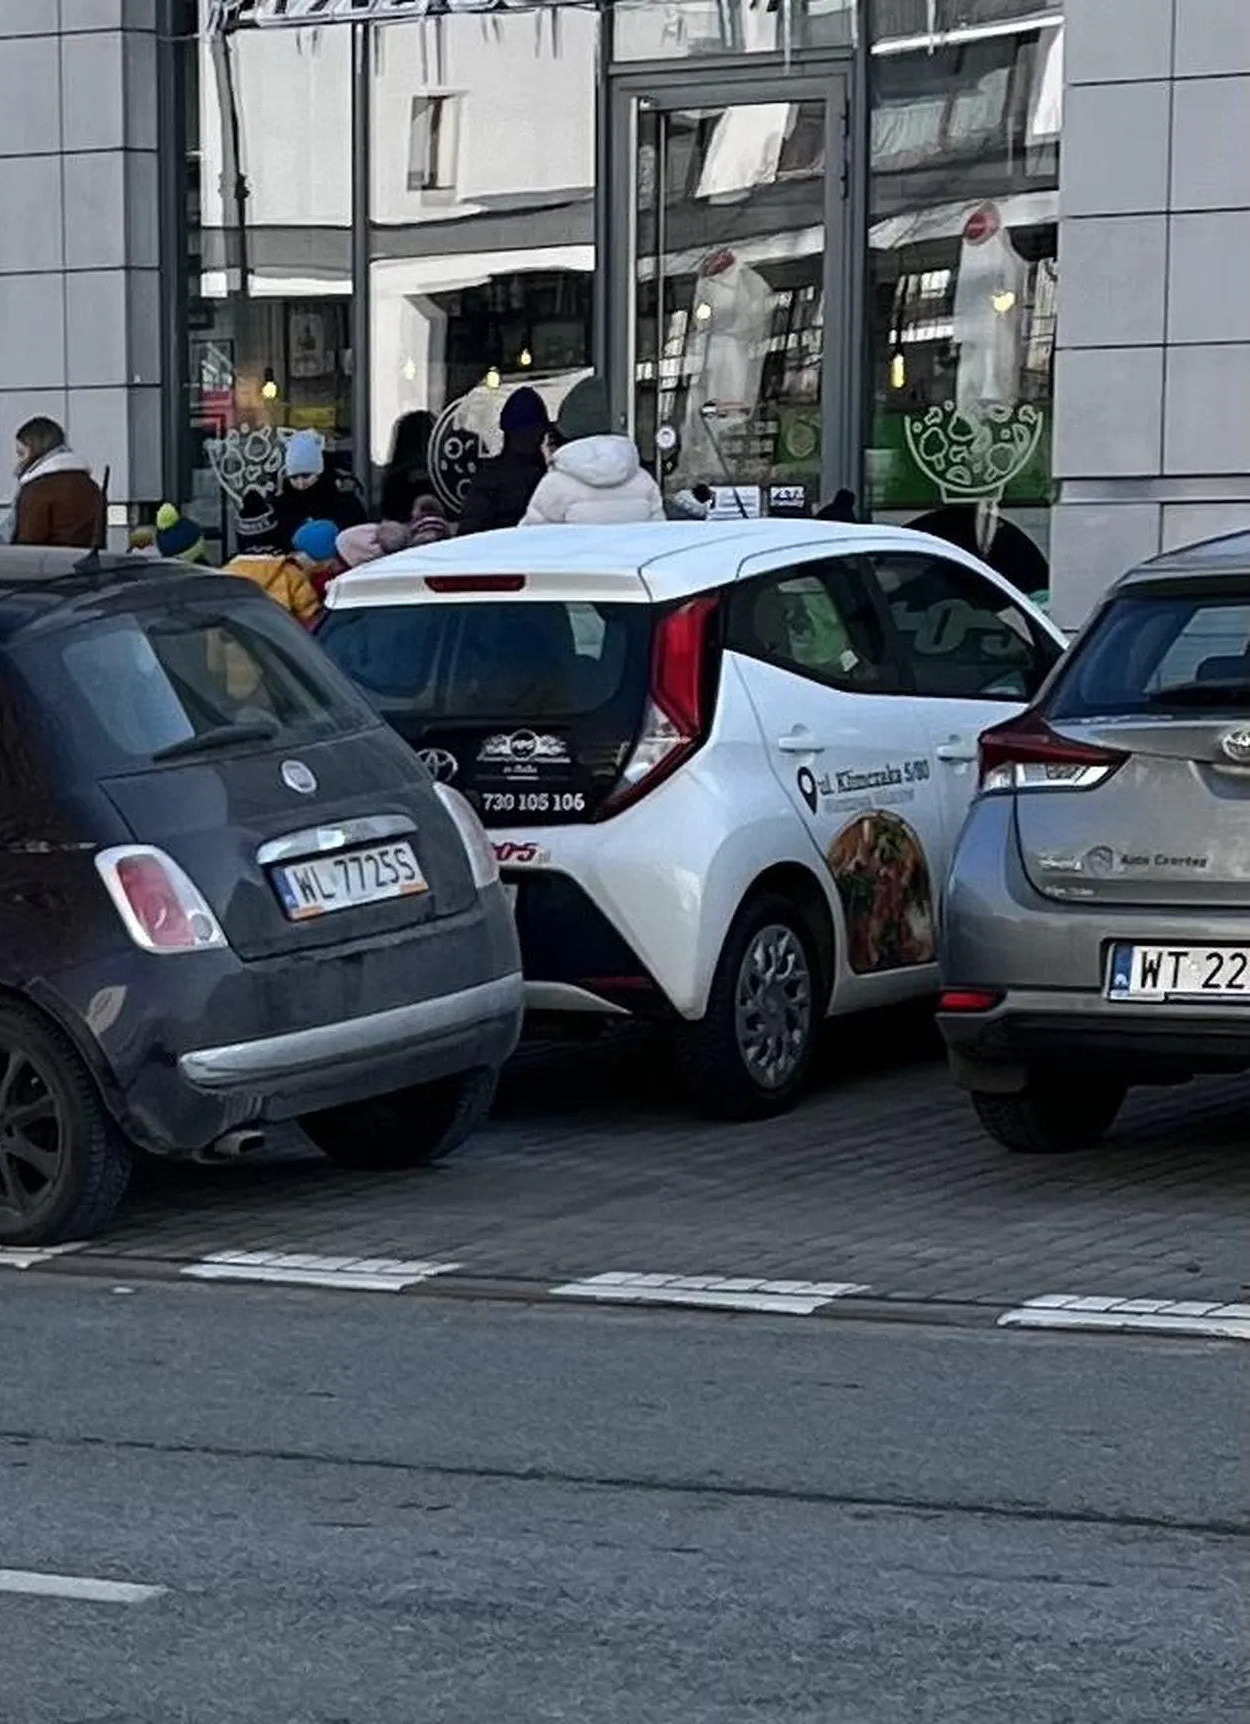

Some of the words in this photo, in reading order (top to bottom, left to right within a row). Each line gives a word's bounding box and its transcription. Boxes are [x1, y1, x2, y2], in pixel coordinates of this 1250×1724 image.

[482, 793, 514, 811] 730
[518, 793, 550, 811] 105
[553, 793, 586, 811] 106
[293, 858, 335, 903] WL
[1141, 951, 1188, 989] WT
[1202, 951, 1248, 989] 22
